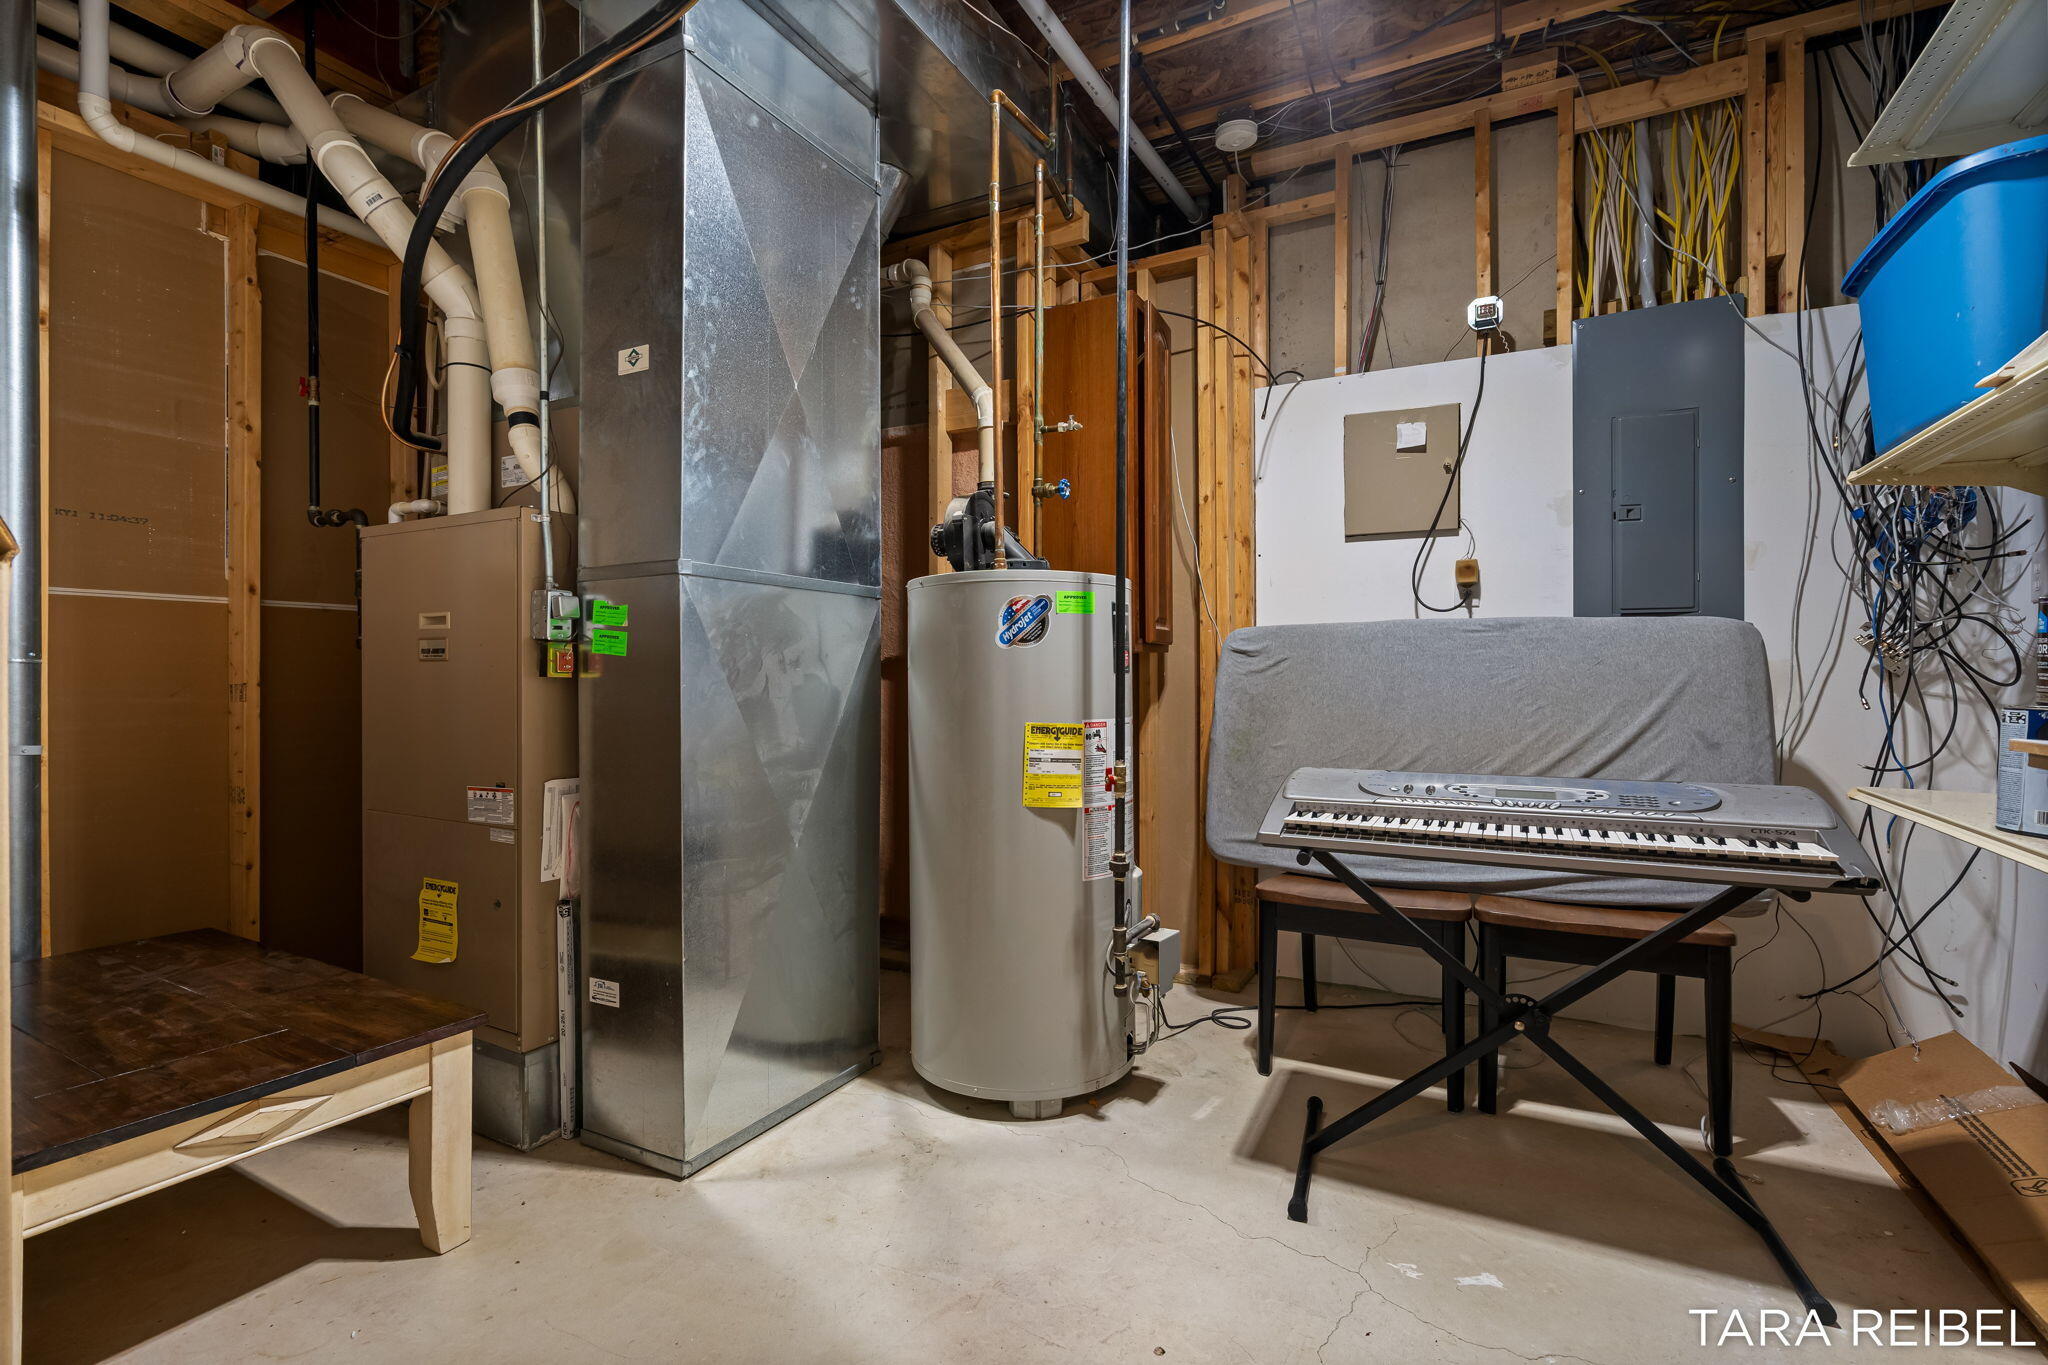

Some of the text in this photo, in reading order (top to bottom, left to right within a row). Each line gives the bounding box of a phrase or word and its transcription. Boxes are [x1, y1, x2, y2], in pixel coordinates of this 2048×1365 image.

[1002, 612, 1033, 642] Hydrojet
[1030, 726, 1083, 737] ENERGYGUIDE
[1750, 828, 1797, 836] CTK-574
